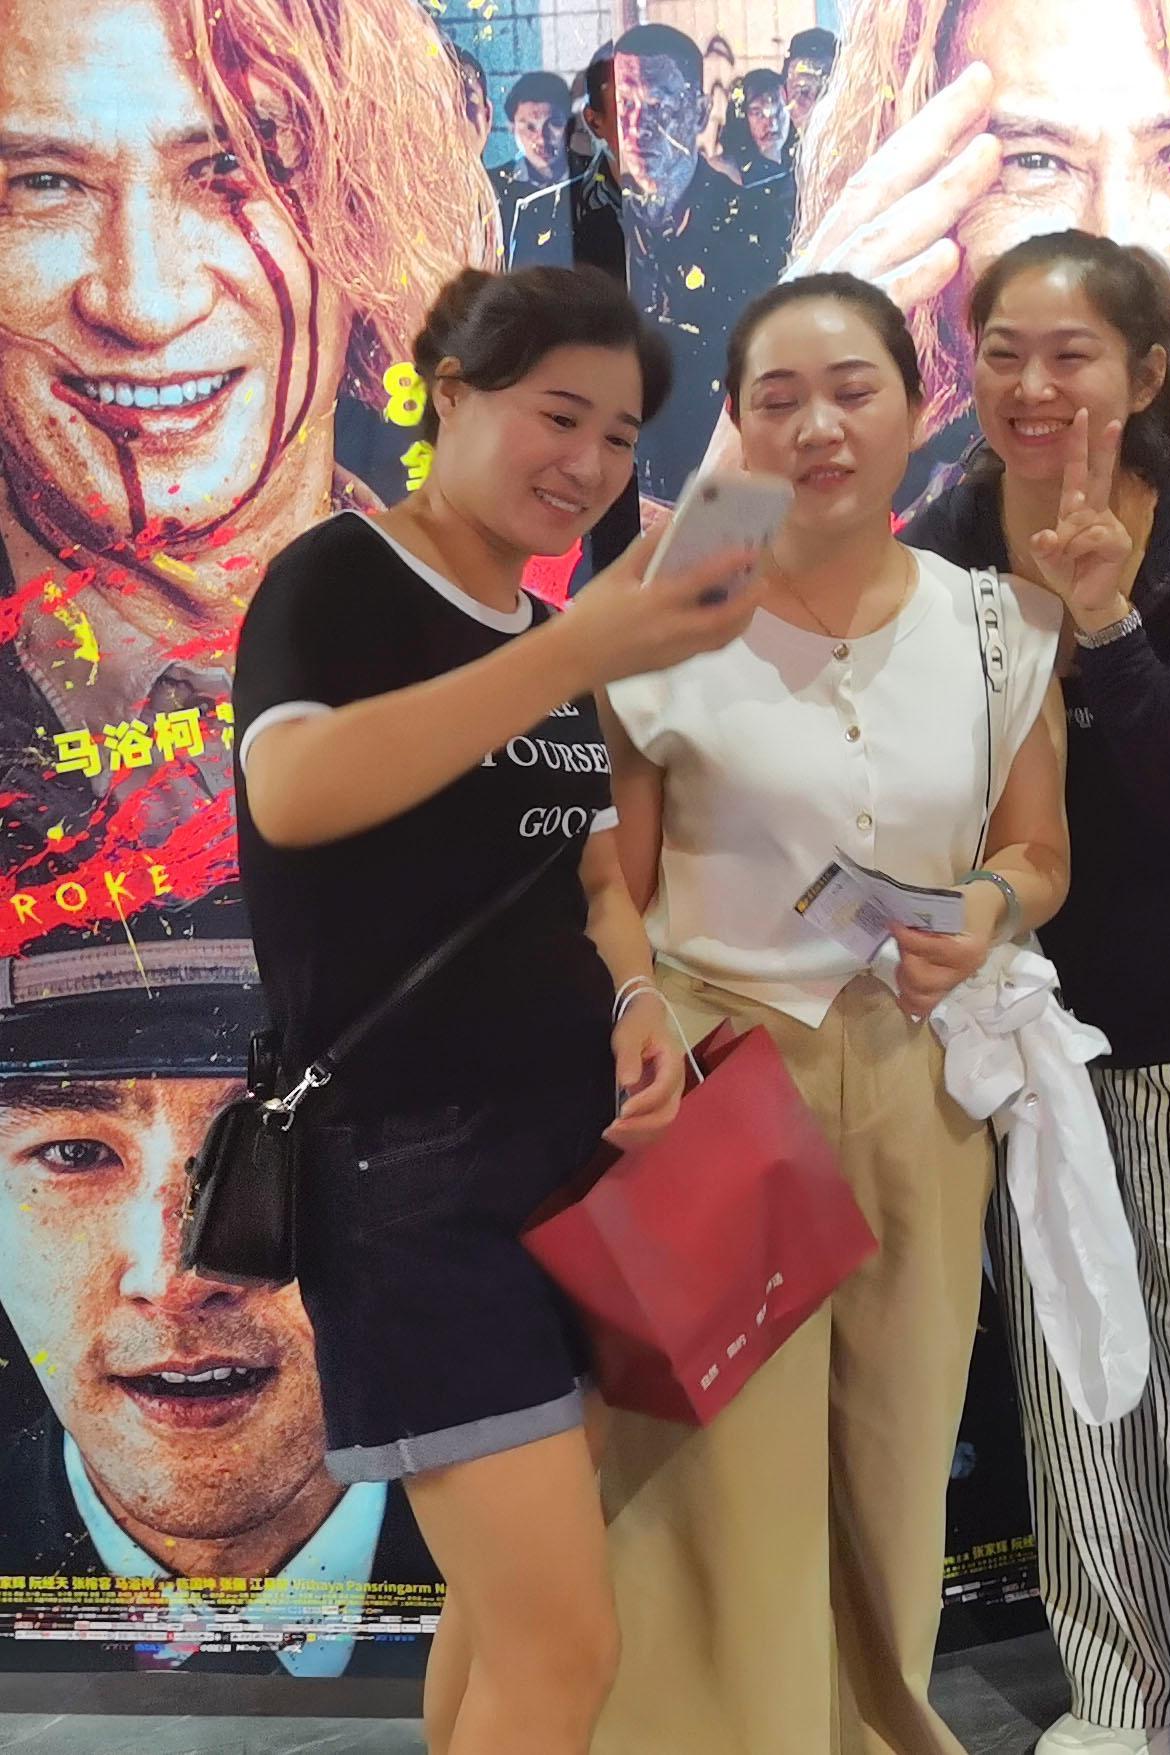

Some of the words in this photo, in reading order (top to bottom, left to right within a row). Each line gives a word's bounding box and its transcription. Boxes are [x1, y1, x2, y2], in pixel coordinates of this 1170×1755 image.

[53, 707, 205, 778] 马浴柯
[481, 735, 612, 774] OURSE
[519, 805, 597, 838] GOO
